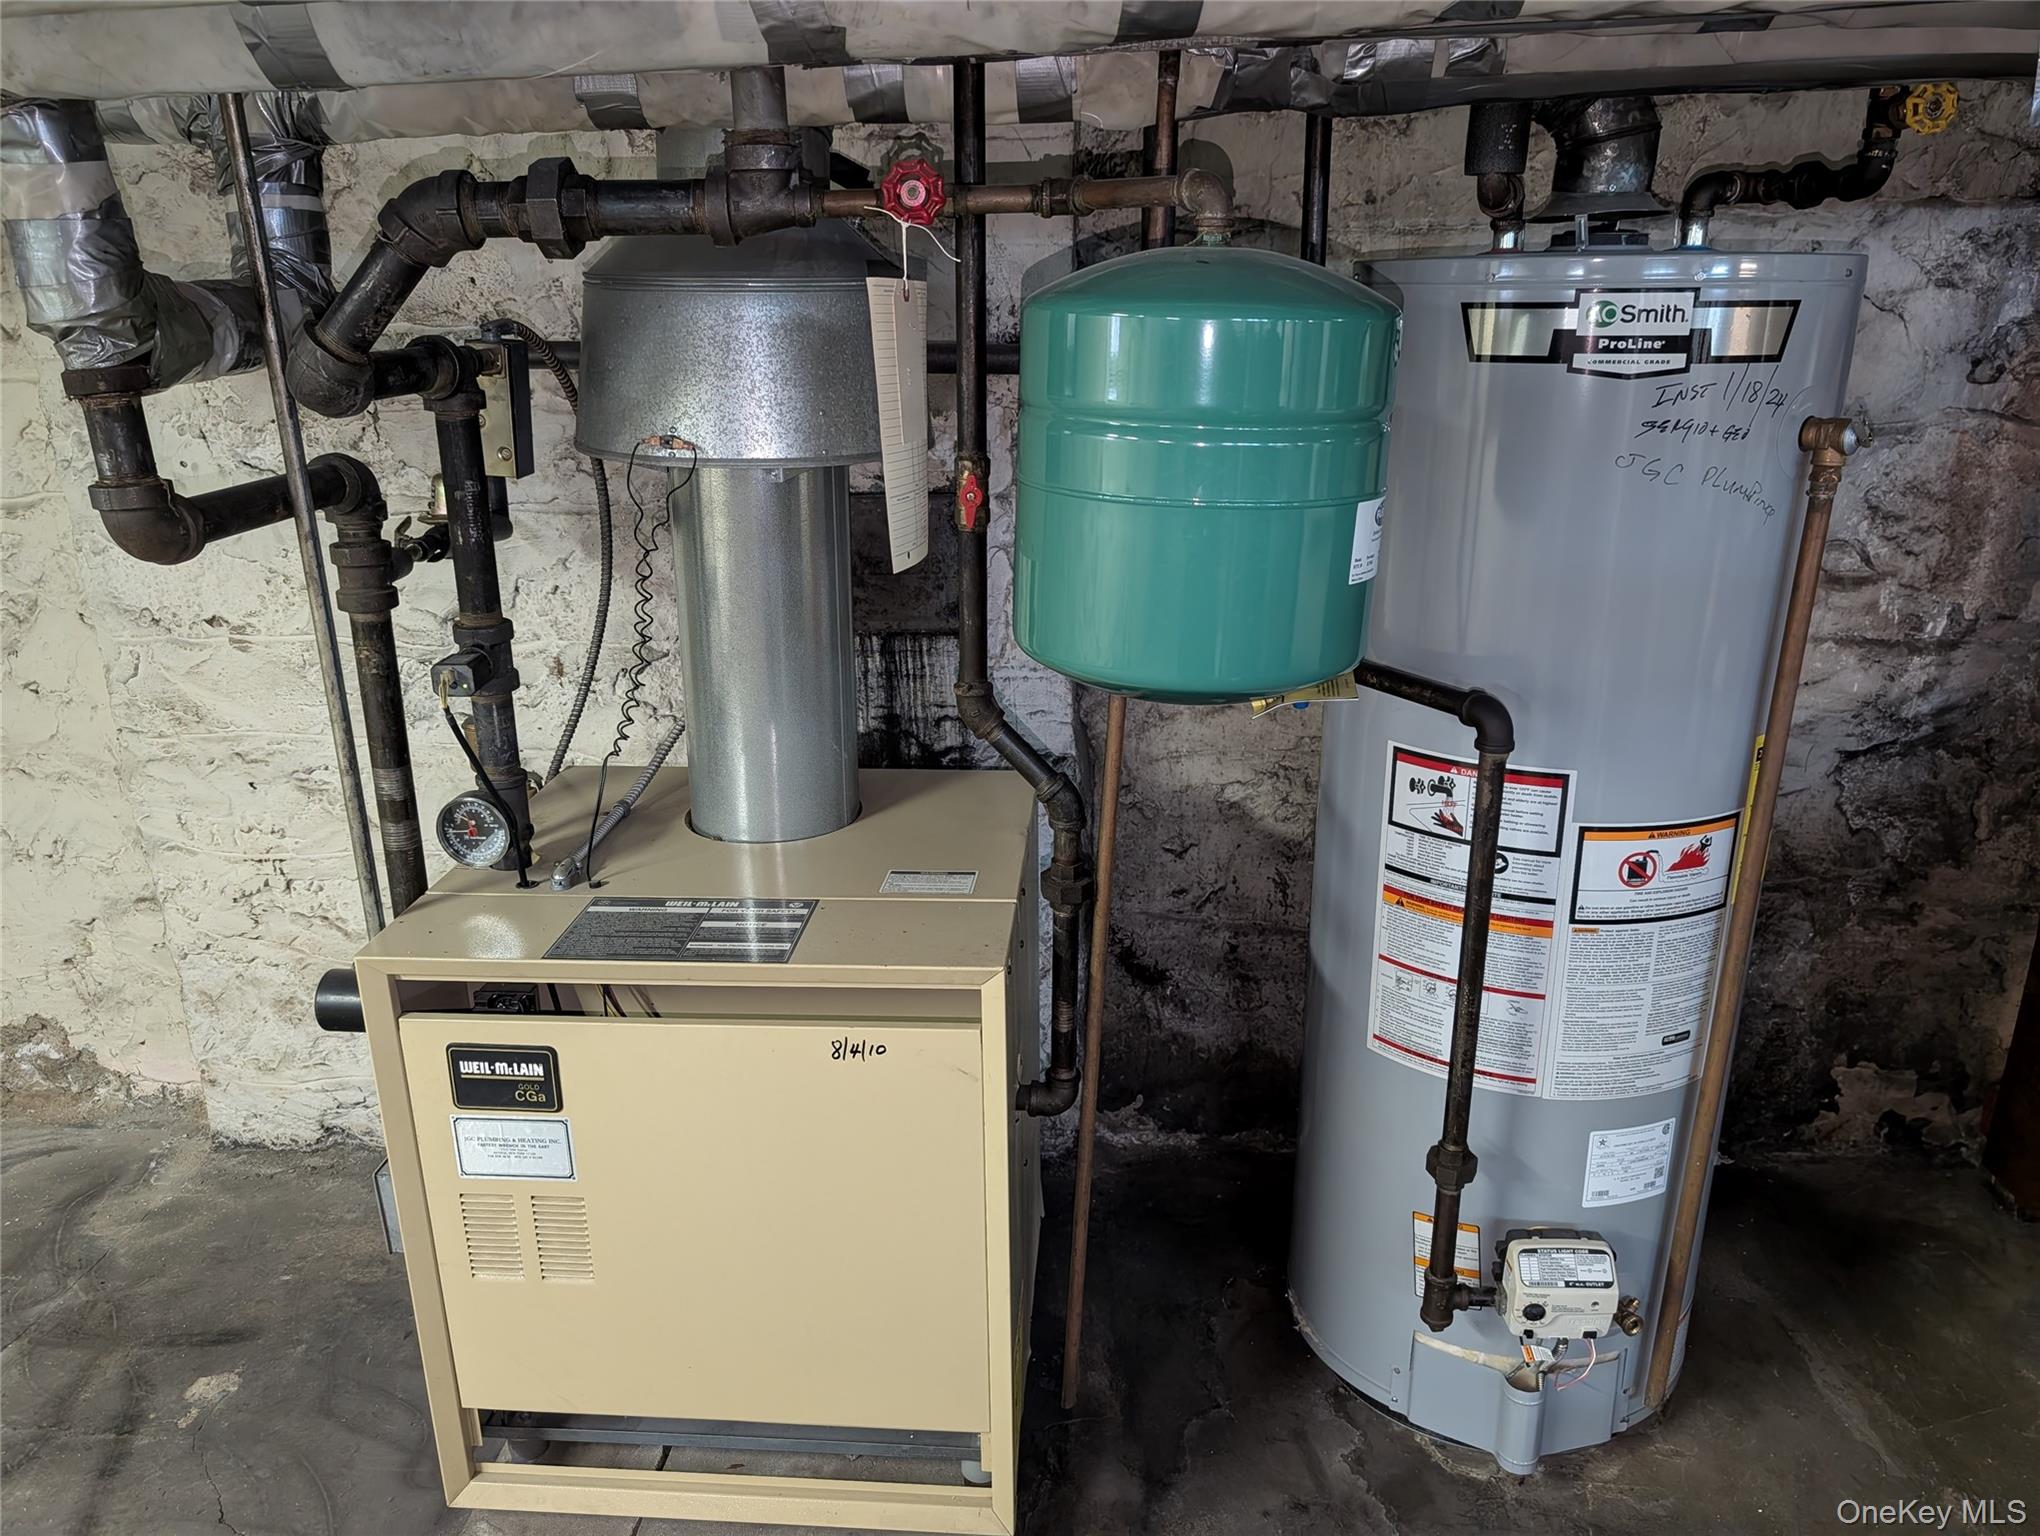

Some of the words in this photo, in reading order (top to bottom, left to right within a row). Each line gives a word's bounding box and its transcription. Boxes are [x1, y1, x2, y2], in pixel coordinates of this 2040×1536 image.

[1620, 304, 1686, 323] Smith
[1598, 338, 1663, 350] ProLine
[1651, 382, 1717, 409] INST
[1615, 453, 1684, 486] JGC
[1656, 829, 1691, 839] WARNING
[831, 1036, 887, 1063] 8/4/10
[517, 1083, 540, 1091] GOLD
[515, 1090, 546, 1102] CGa
